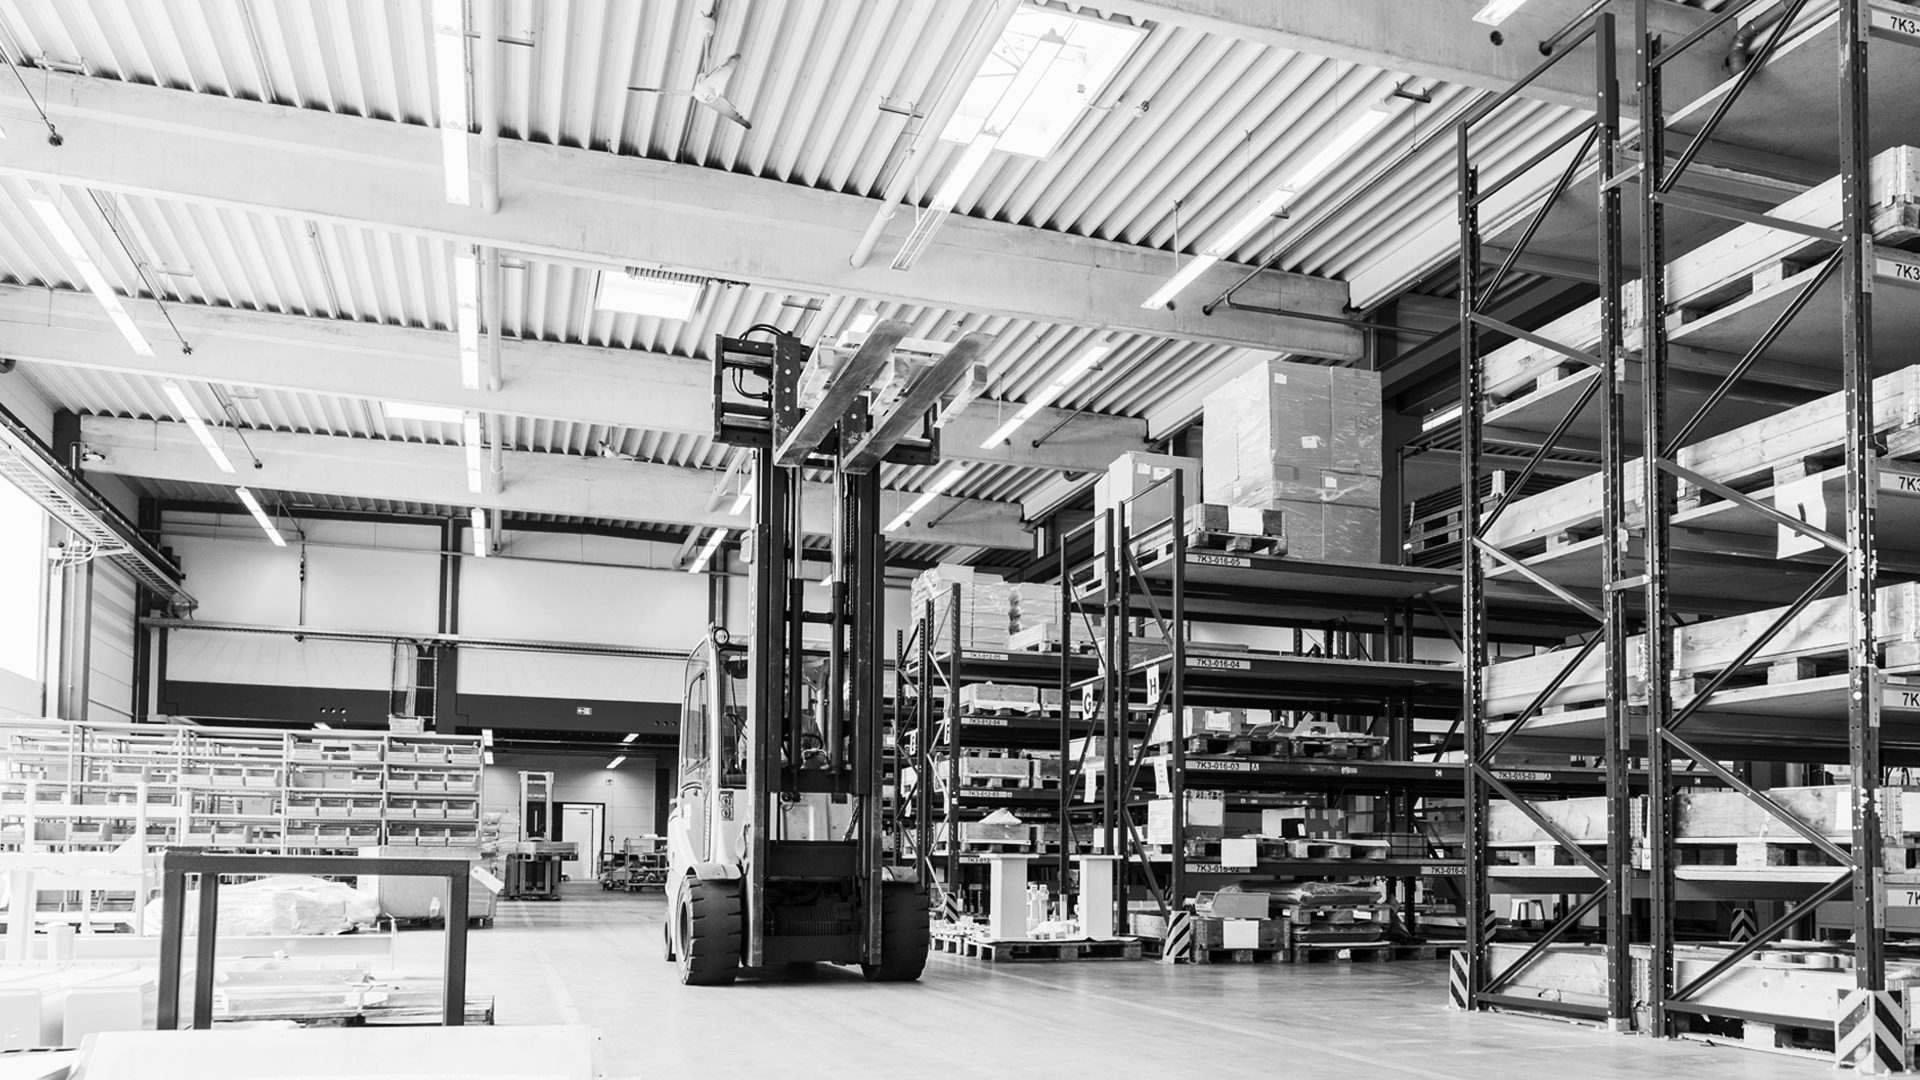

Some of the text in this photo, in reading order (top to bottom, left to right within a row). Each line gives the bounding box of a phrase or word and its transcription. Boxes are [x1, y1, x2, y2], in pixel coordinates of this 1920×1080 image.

[1197, 556, 1240, 566] 7K3-016-05
[1197, 658, 1240, 668] 7K3-016-04
[1150, 678, 1156, 695] H
[1084, 693, 1091, 714] G
